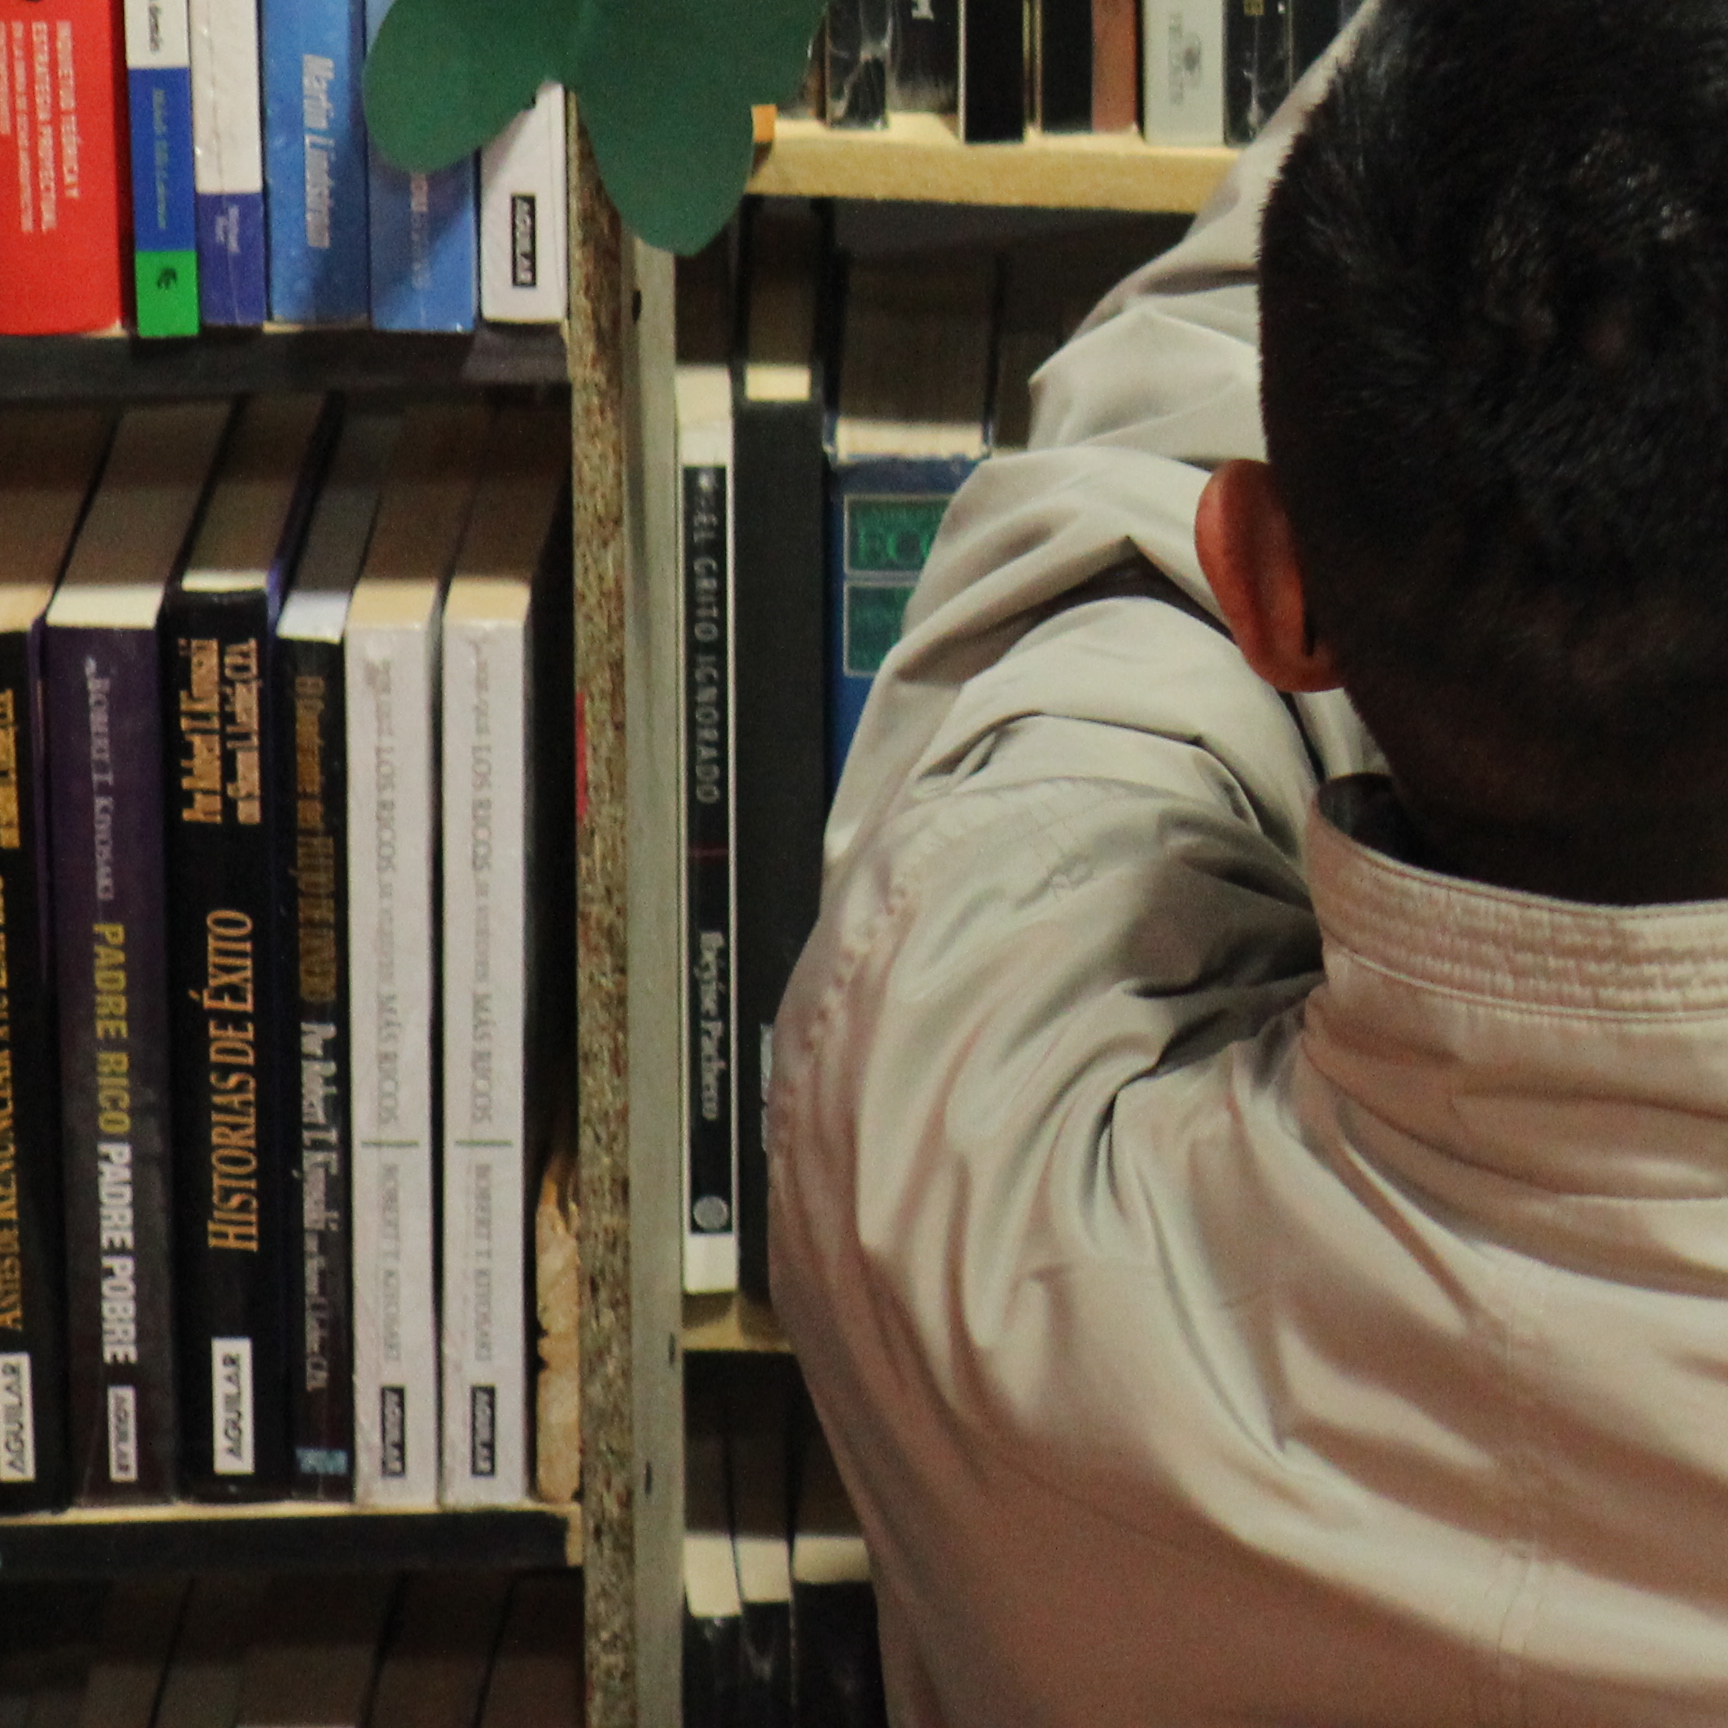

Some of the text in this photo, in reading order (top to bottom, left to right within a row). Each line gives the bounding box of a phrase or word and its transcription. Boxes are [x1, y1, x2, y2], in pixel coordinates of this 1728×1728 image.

[303, 53, 332, 249] Martin Lindstrom
[513, 200, 534, 281] AGUILAR
[191, 907, 258, 1251] HISTORIAS DE ÉXITO
[95, 923, 137, 1363] PADRE RICO PADRE POBRE
[8, 1362, 26, 1478] AGUILAR
[223, 1351, 244, 1461] AGUILAR
[474, 1390, 495, 1475] AGUILAR
